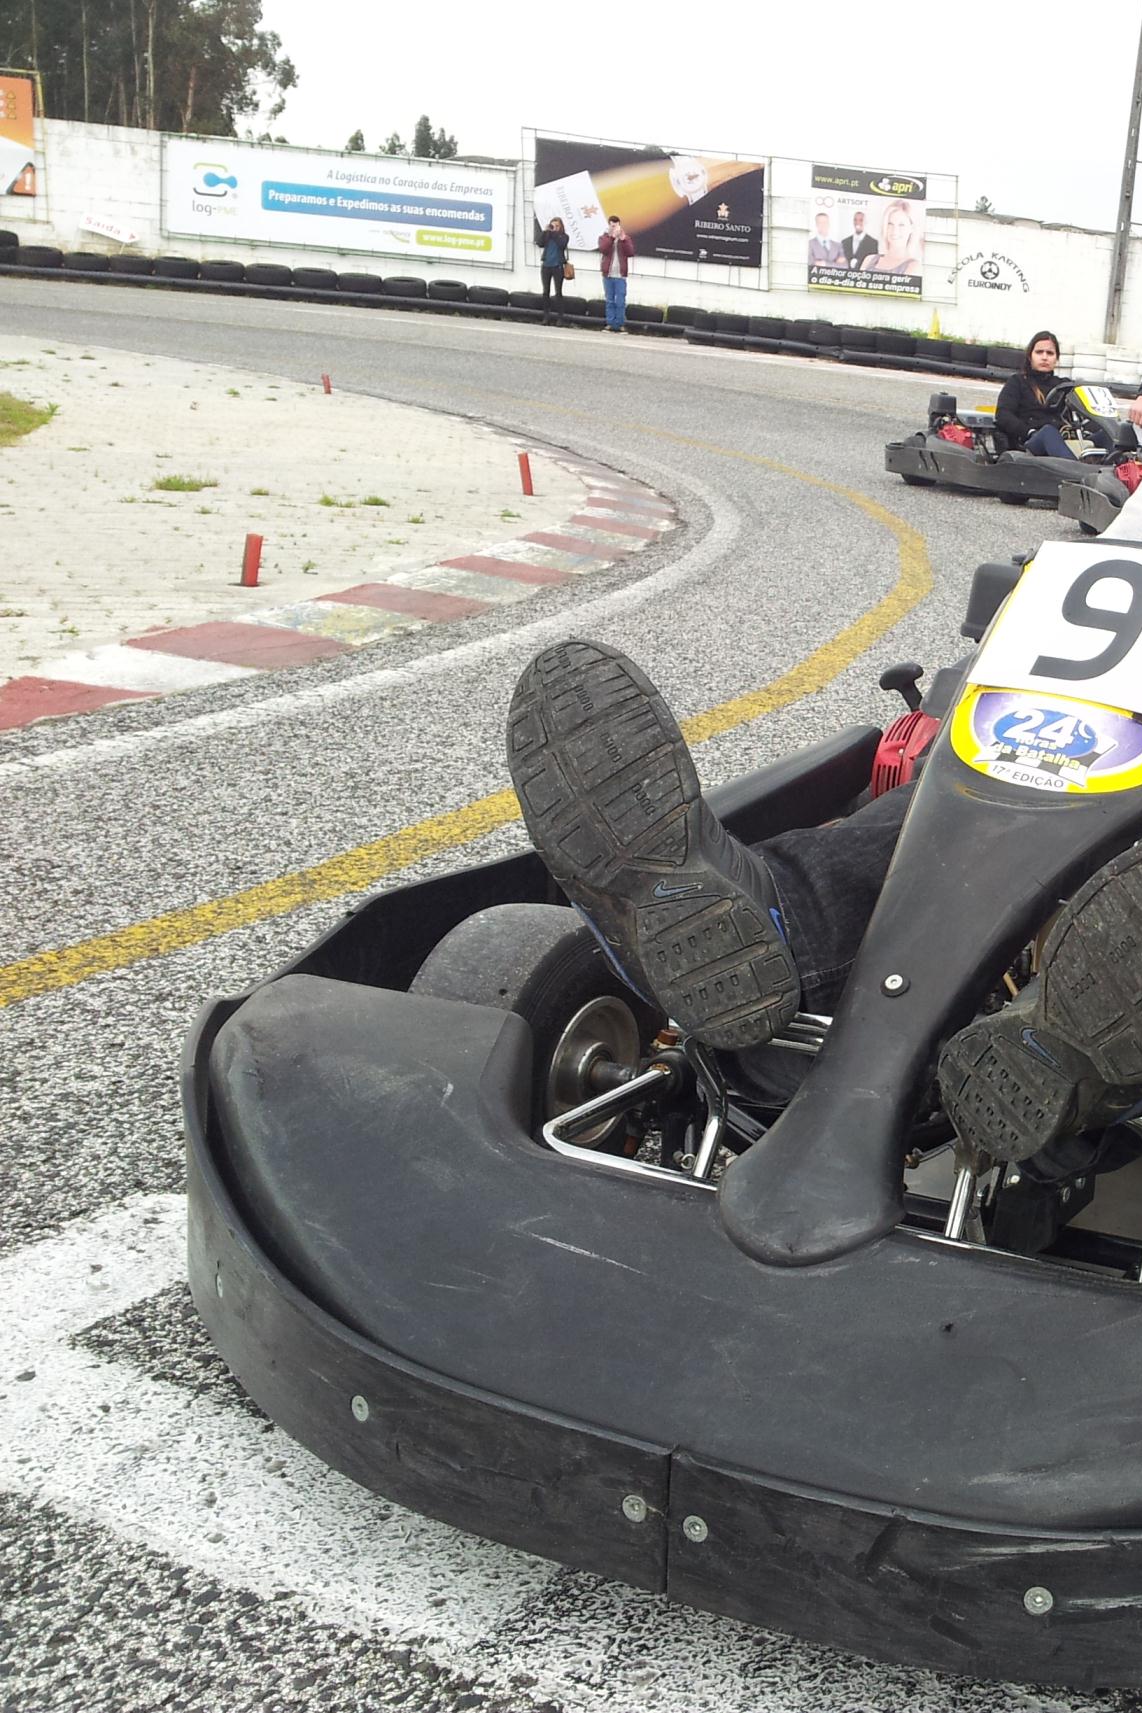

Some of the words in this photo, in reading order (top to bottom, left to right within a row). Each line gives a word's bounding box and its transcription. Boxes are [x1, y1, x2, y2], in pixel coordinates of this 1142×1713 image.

[327, 169, 334, 178] A
[335, 170, 377, 184] Logística
[379, 176, 391, 185] no
[393, 176, 430, 190] Coração
[431, 180, 448, 191] das
[449, 182, 493, 196] Empresas
[814, 175, 860, 187] www.apri.pt
[891, 181, 913, 193] apri
[268, 189, 327, 205] Preparamos
[328, 197, 336, 206] e
[337, 196, 389, 212] Expedimos
[390, 204, 401, 213] as
[402, 205, 424, 216] suas
[425, 208, 485, 221] encomendas
[837, 197, 869, 206] ARTSOFT
[694, 219, 724, 231] RIBEIRO
[725, 222, 752, 233] SANTO
[811, 266, 818, 274] A
[819, 267, 847, 278] melhor
[847, 270, 872, 282] opção
[872, 273, 891, 283] para
[891, 274, 912, 284] gerir
[947, 251, 984, 285] ESCOLA
[991, 251, 1030, 293] KARTING
[818, 276, 855, 287] dia-a-dia
[856, 279, 867, 288] da
[868, 281, 883, 290] sua
[884, 283, 920, 294] empresa
[968, 279, 1012, 291] EUROINDY
[1002, 708, 1075, 749] 24
[1015, 744, 1081, 771] Batalha
[1012, 771, 1065, 788] EDIÇÃO
